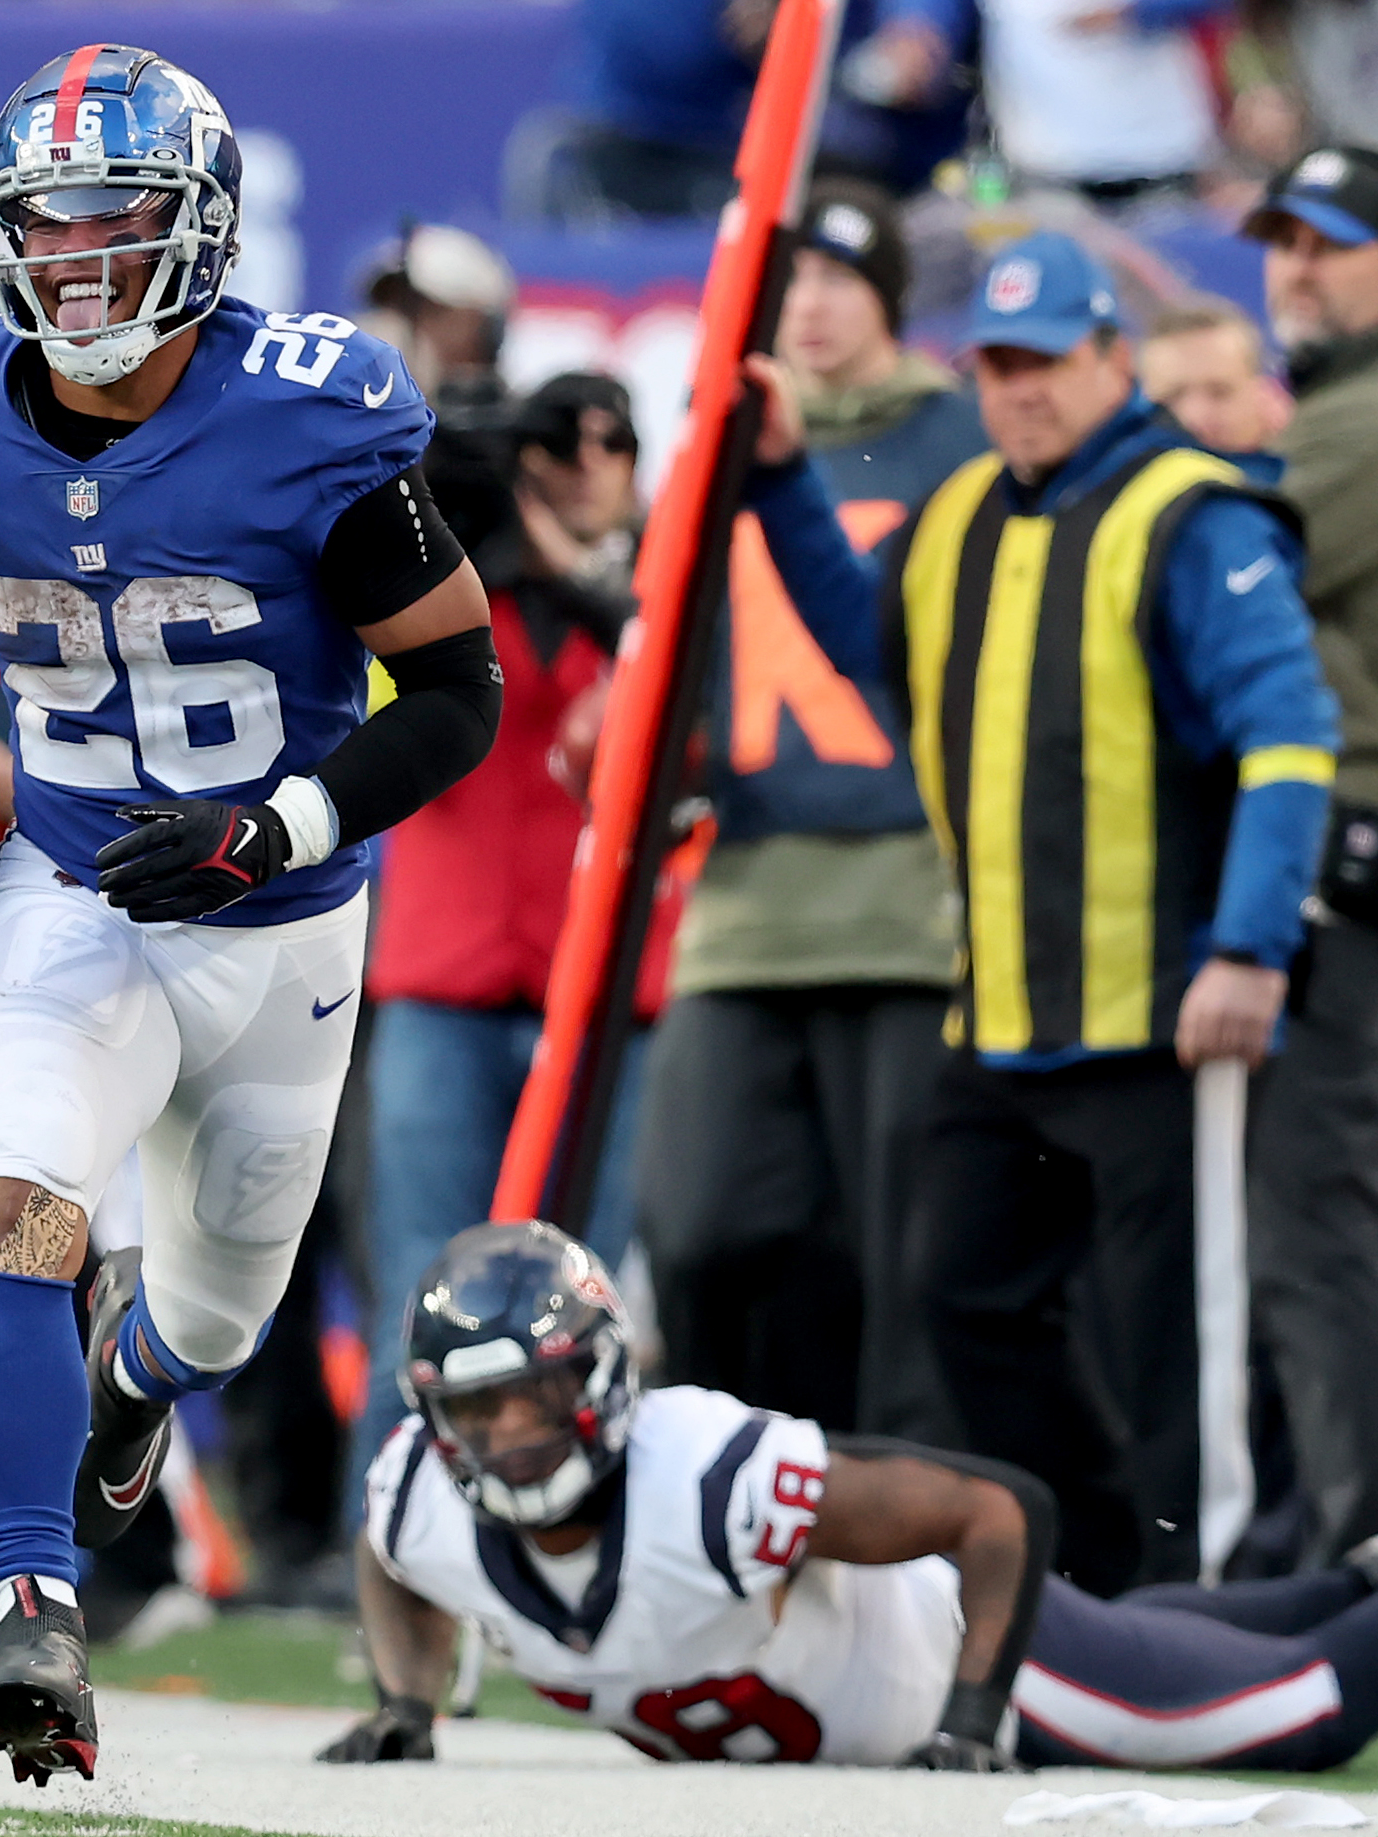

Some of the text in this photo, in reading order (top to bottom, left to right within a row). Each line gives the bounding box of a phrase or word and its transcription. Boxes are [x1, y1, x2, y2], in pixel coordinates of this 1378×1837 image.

[29, 101, 104, 143] 26
[241, 312, 358, 389] 26
[71, 495, 96, 512] NFL
